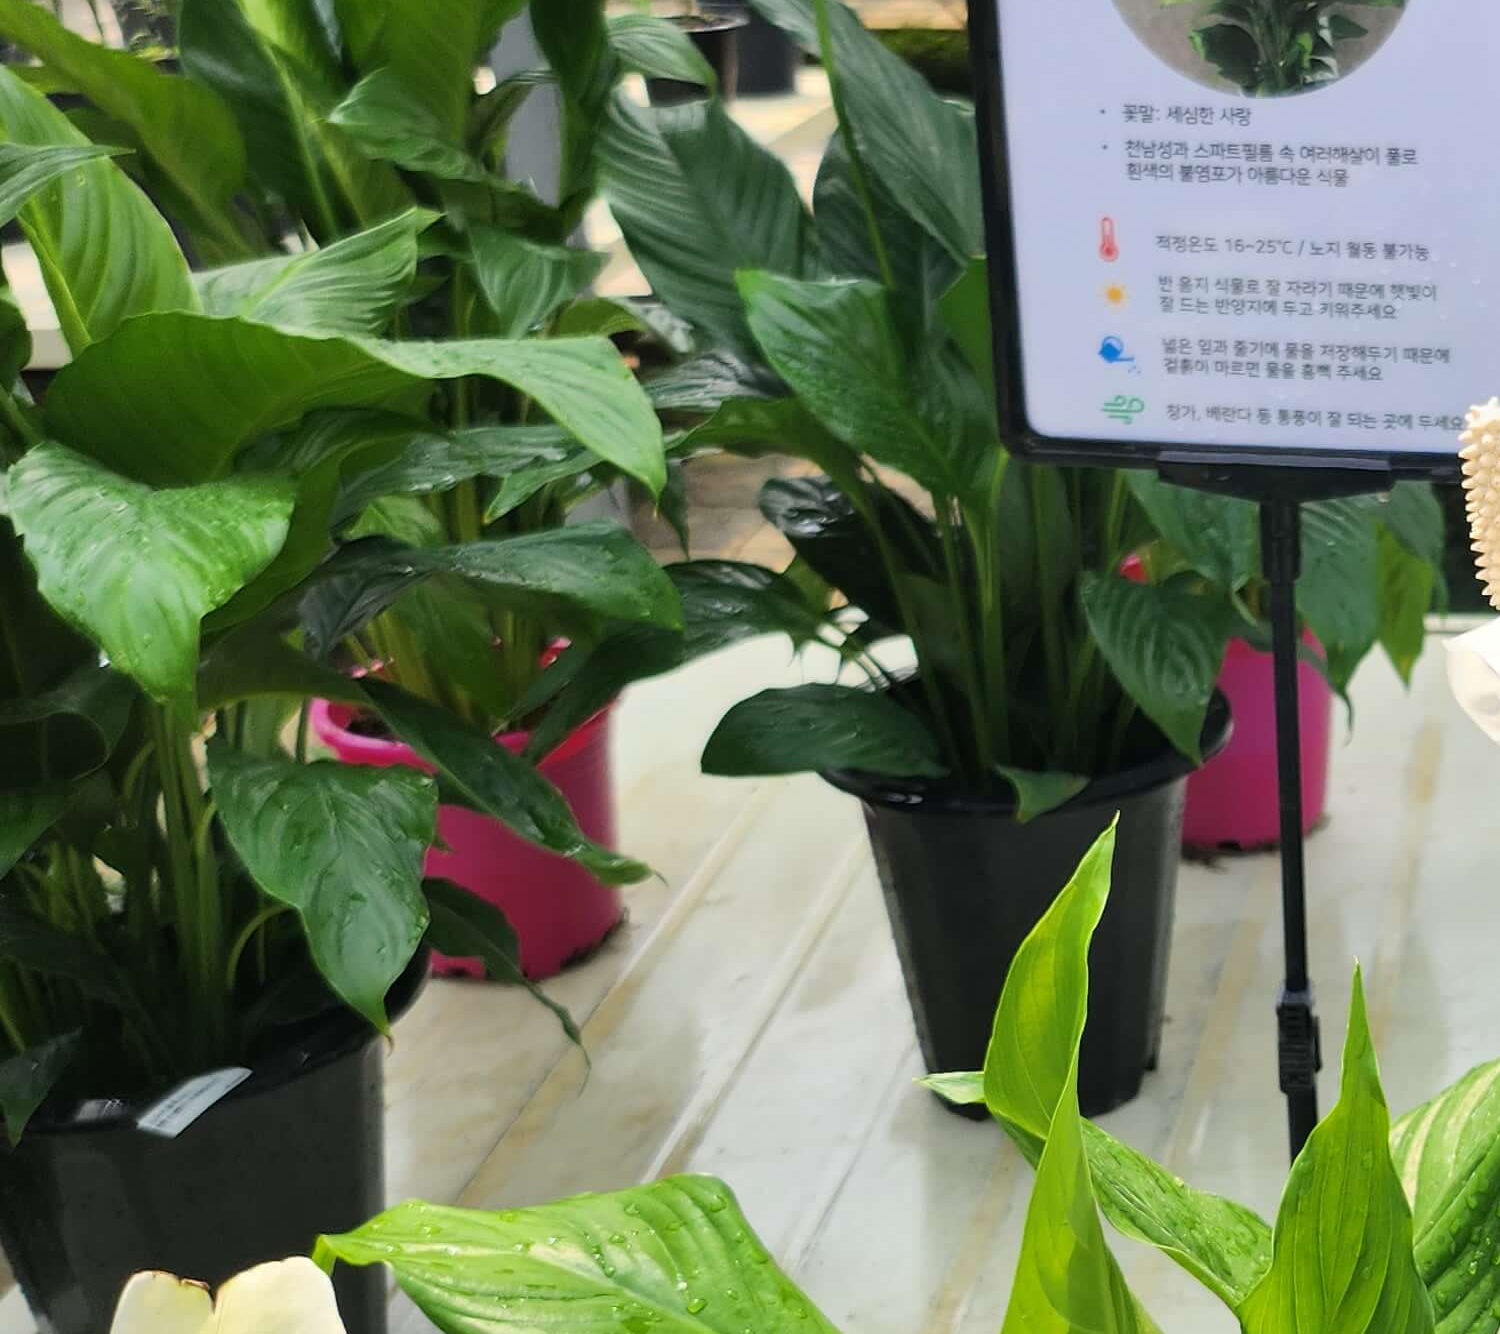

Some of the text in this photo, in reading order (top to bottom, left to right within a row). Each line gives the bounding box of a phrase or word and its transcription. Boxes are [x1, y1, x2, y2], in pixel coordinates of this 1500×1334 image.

[1122, 104, 1252, 126] 꽃말: 세심한 사랑
[1125, 140, 1419, 166] 천남성과 스파트필름 속 여러해살이 풀로
[1126, 163, 1349, 187] 흰색의 불염포가 아름다운 식물
[1155, 235, 1219, 253] 적정온도
[1309, 241, 1341, 257] 노지
[1346, 242, 1377, 259] 월동
[1383, 243, 1430, 261] 불가능
[1158, 275, 1173, 293] 반
[1214, 277, 1260, 295] 식물로
[1266, 279, 1281, 297] 잘
[1286, 280, 1332, 298] 자라기
[1337, 282, 1385, 299] 때문에
[1390, 283, 1437, 301] 햇빛이
[1159, 296, 1398, 320] 잘 드는 반양지에 두고 키워주세요
[1162, 338, 1450, 365] 넓은 잎과 줄기에 물을 저장해두기 때문에
[1164, 358, 1384, 381] 겉흙이 마르면 물을 흠뻑 주세요
[1167, 404, 1471, 431] 창가, 베란다 등 통풍이 잘 되는 곳에 두세요
